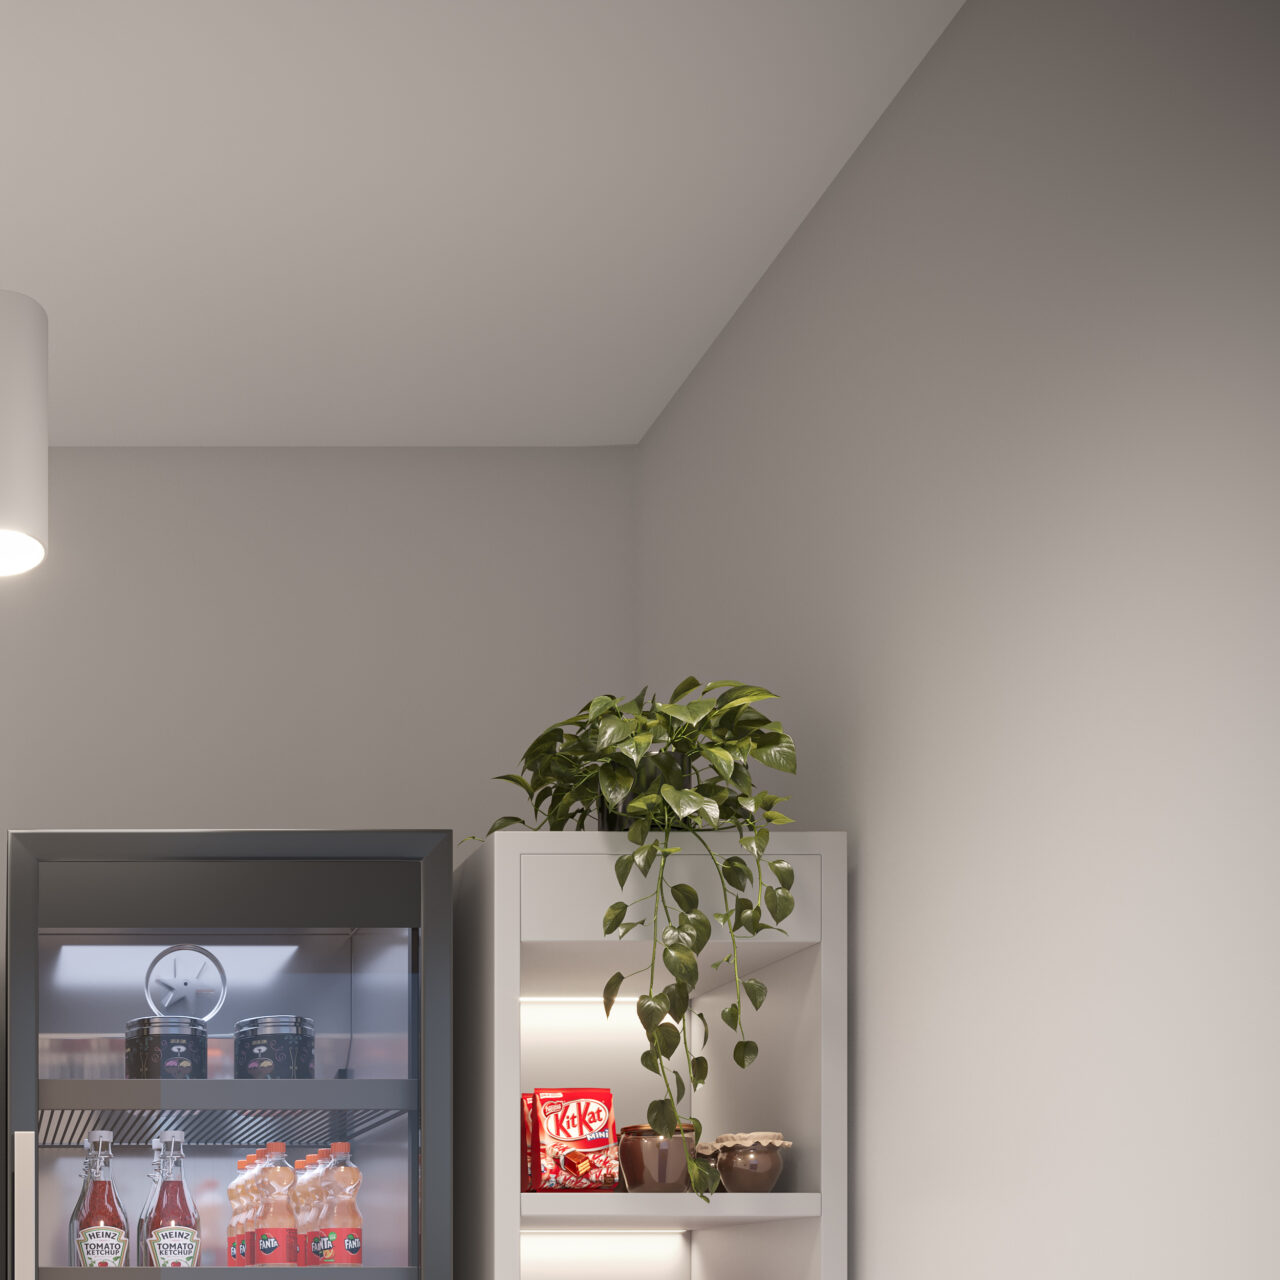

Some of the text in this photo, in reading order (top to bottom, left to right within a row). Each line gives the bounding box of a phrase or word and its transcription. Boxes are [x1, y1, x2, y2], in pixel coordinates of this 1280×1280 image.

[88, 1231, 118, 1240] HEINZ
[161, 1231, 191, 1240] HEINZ
[259, 1238, 278, 1250] FANTA
